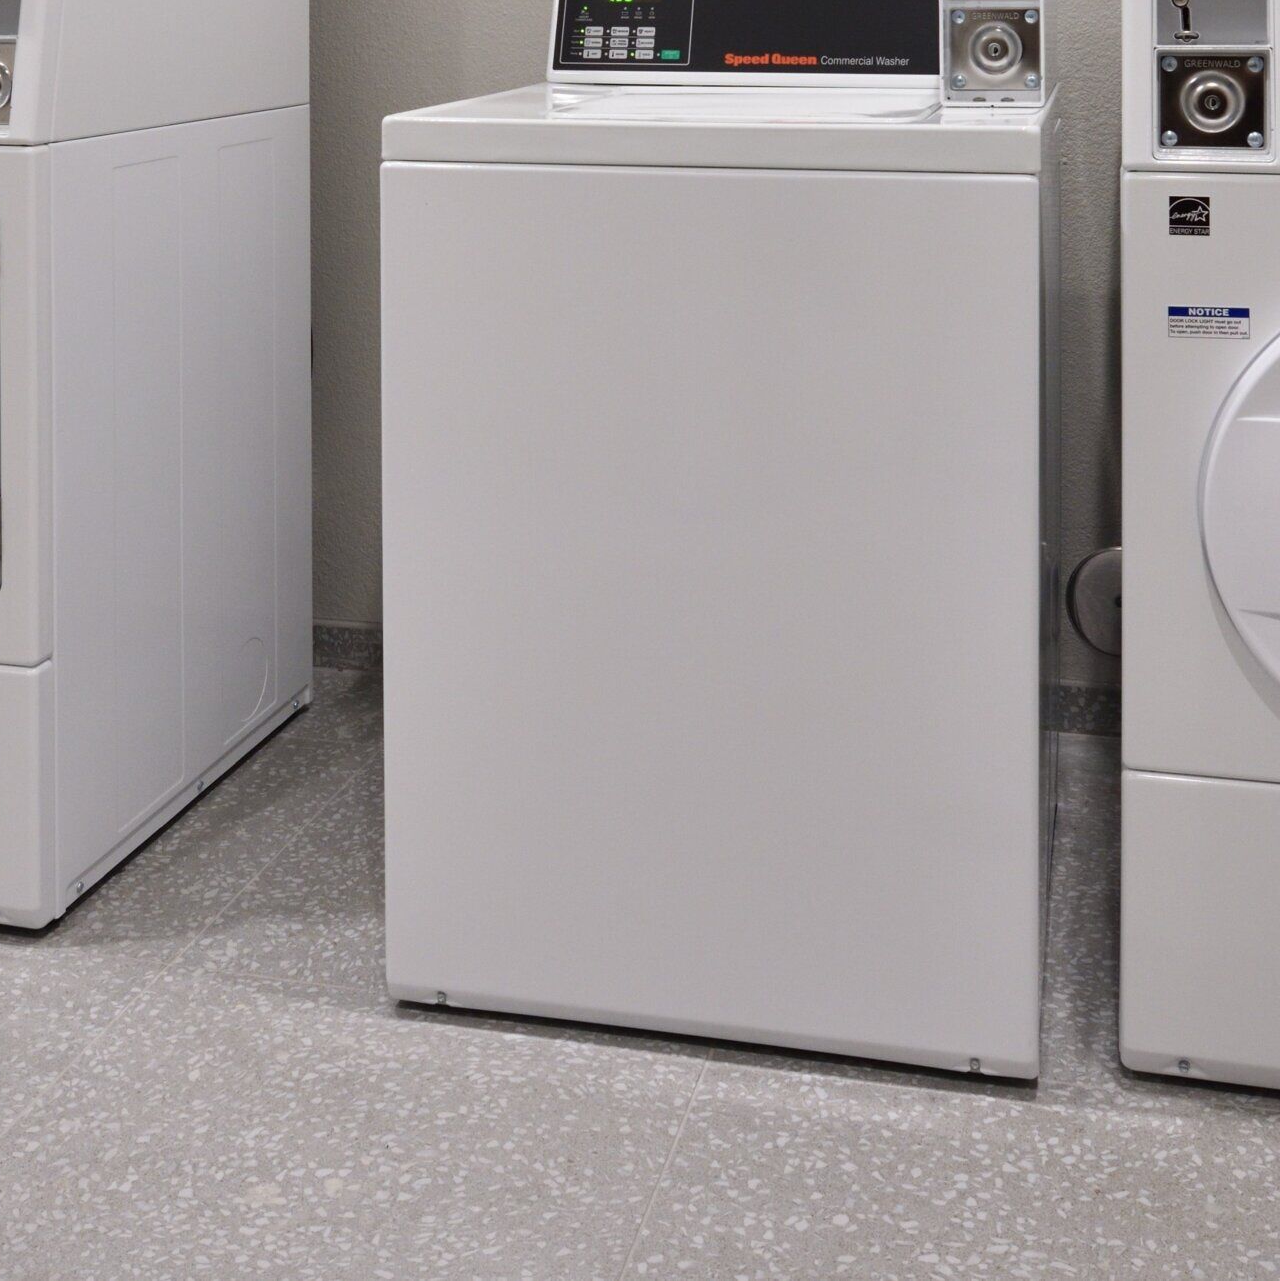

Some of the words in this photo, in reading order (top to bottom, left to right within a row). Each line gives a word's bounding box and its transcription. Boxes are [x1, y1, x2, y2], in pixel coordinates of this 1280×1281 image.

[724, 53, 769, 66] Speed
[771, 53, 817, 65] Queen
[820, 55, 874, 66] Commercial
[876, 56, 910, 66] Washer
[1184, 59, 1241, 68] GREENWALD
[1188, 307, 1230, 317] NOTICE
